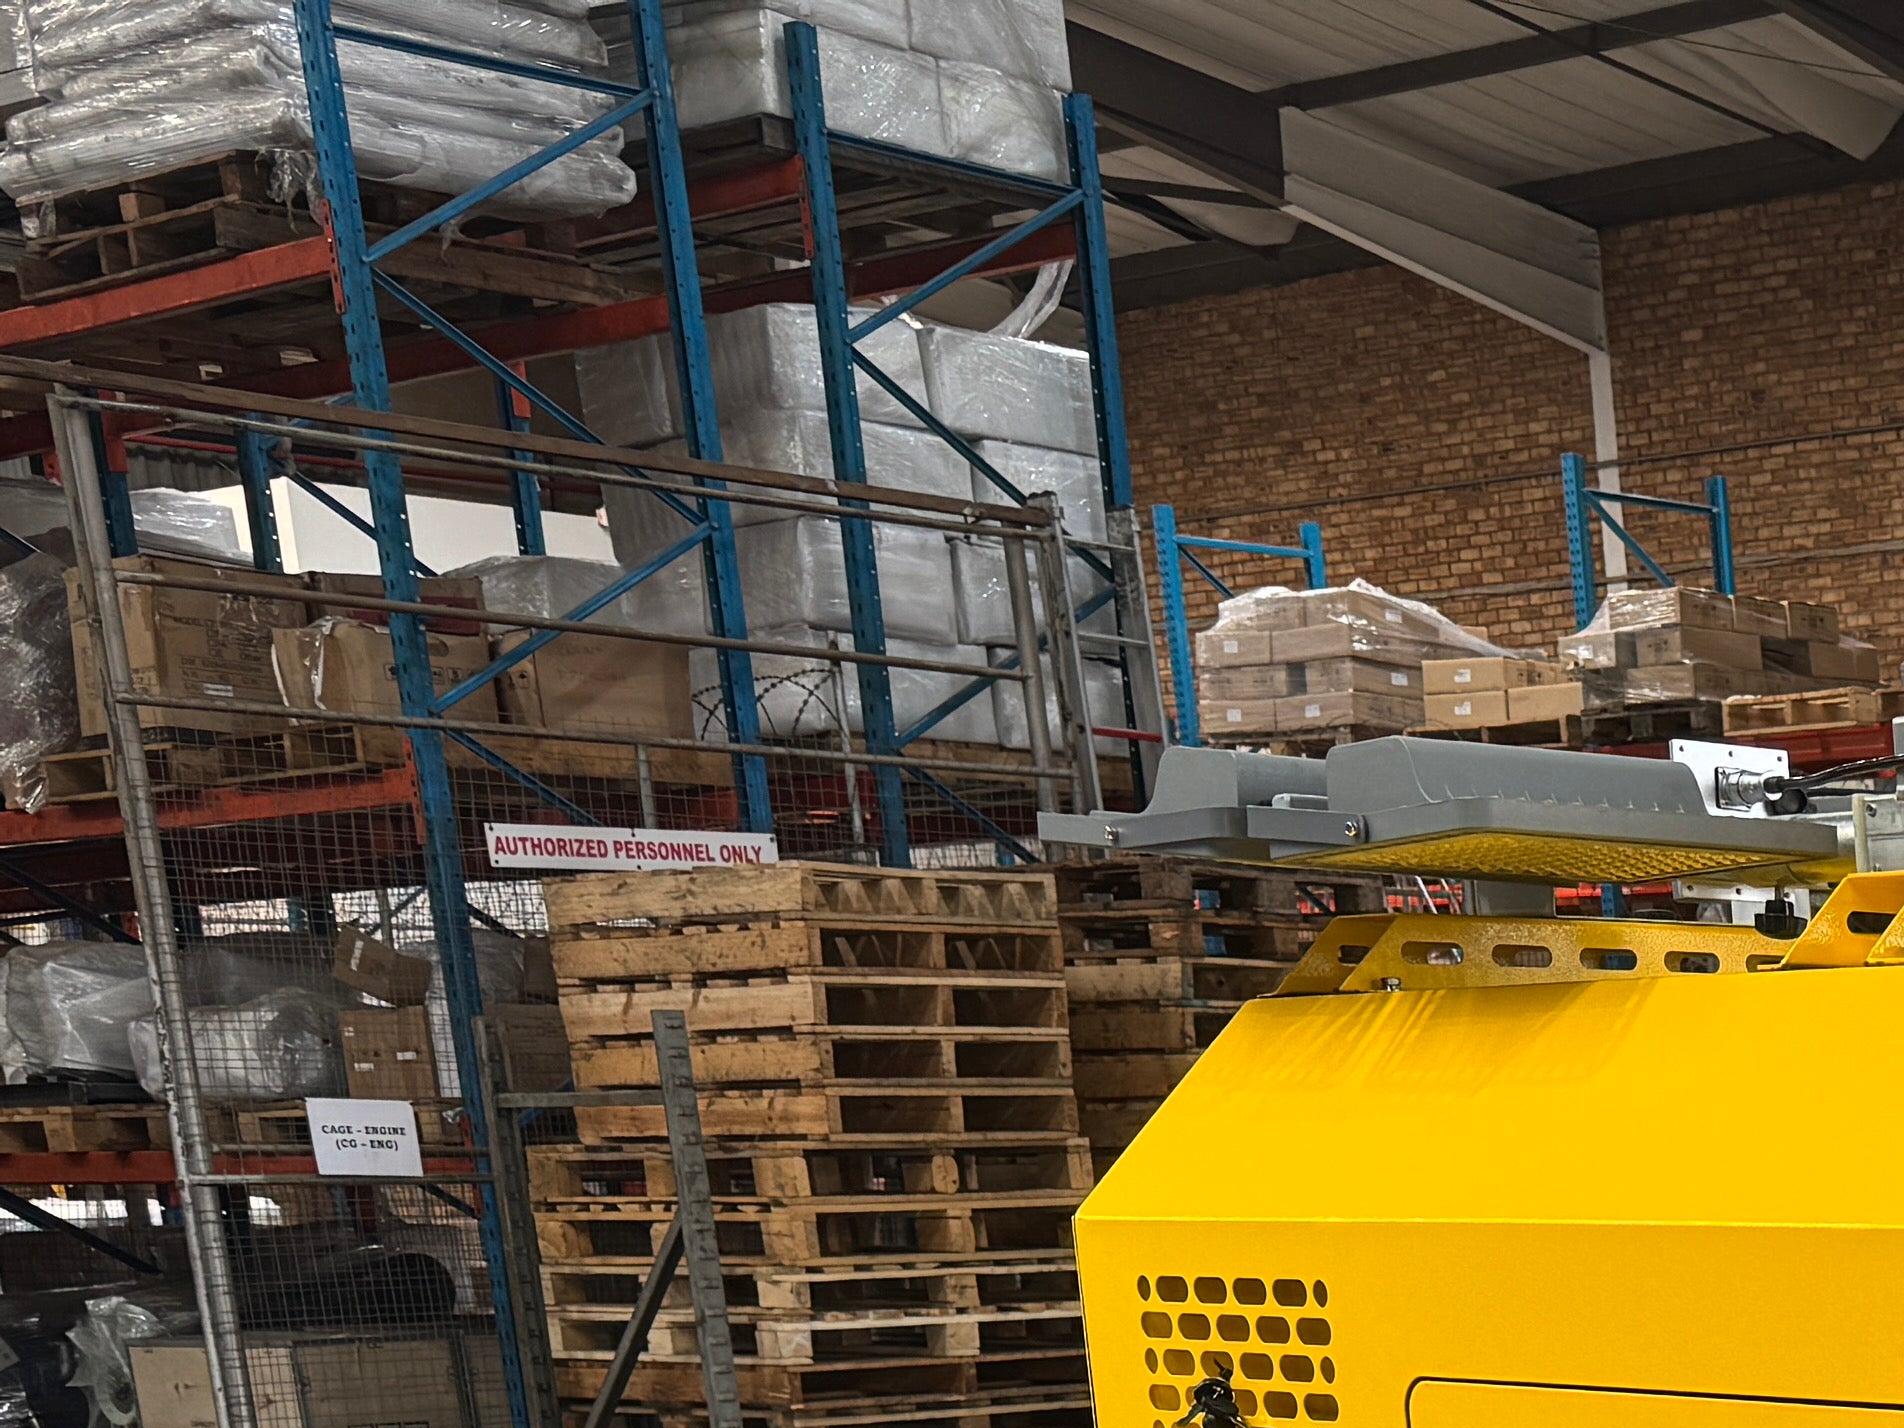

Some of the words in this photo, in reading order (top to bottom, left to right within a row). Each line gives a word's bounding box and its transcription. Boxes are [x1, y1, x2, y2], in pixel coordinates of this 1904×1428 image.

[495, 836, 608, 859] AUTHORIZED
[613, 840, 716, 863] PERSONNEL
[719, 844, 763, 865] ONLY
[321, 1124, 353, 1135] CAGE
[364, 1126, 406, 1136] ENGINE
[369, 1139, 398, 1152] ENG)
